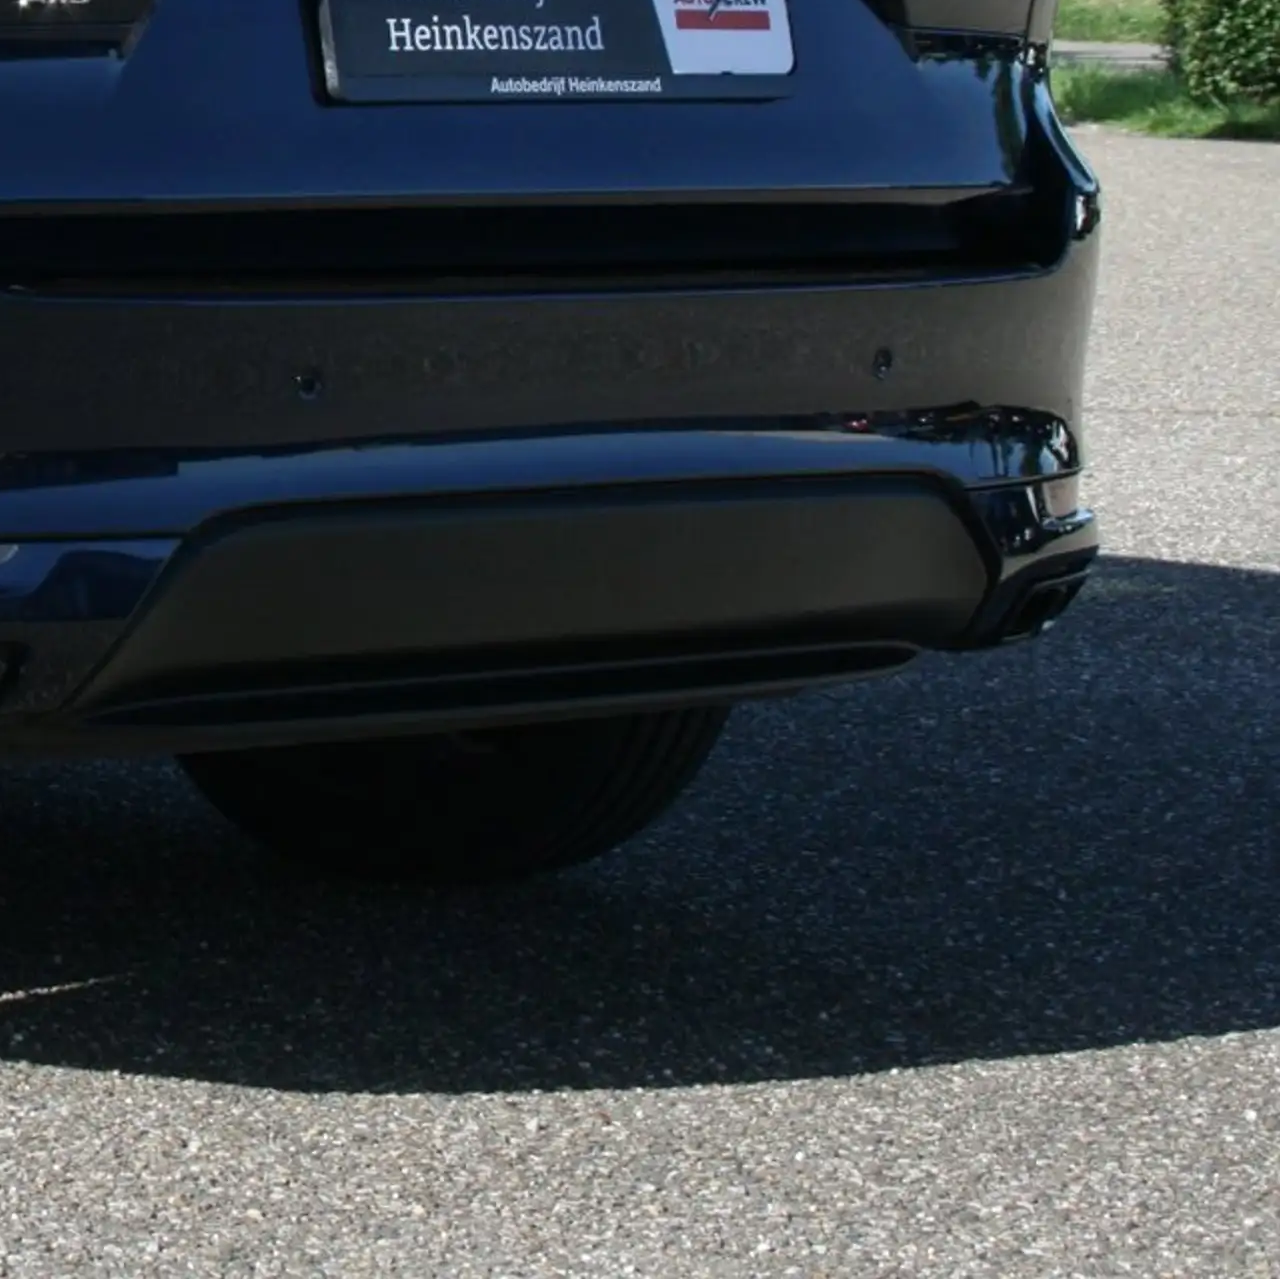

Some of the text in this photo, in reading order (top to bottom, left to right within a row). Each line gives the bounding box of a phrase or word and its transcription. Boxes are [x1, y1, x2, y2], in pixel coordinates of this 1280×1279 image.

[386, 15, 605, 51] Heinkenszand
[491, 76, 662, 96] Autobedrijf Heinkenszand
